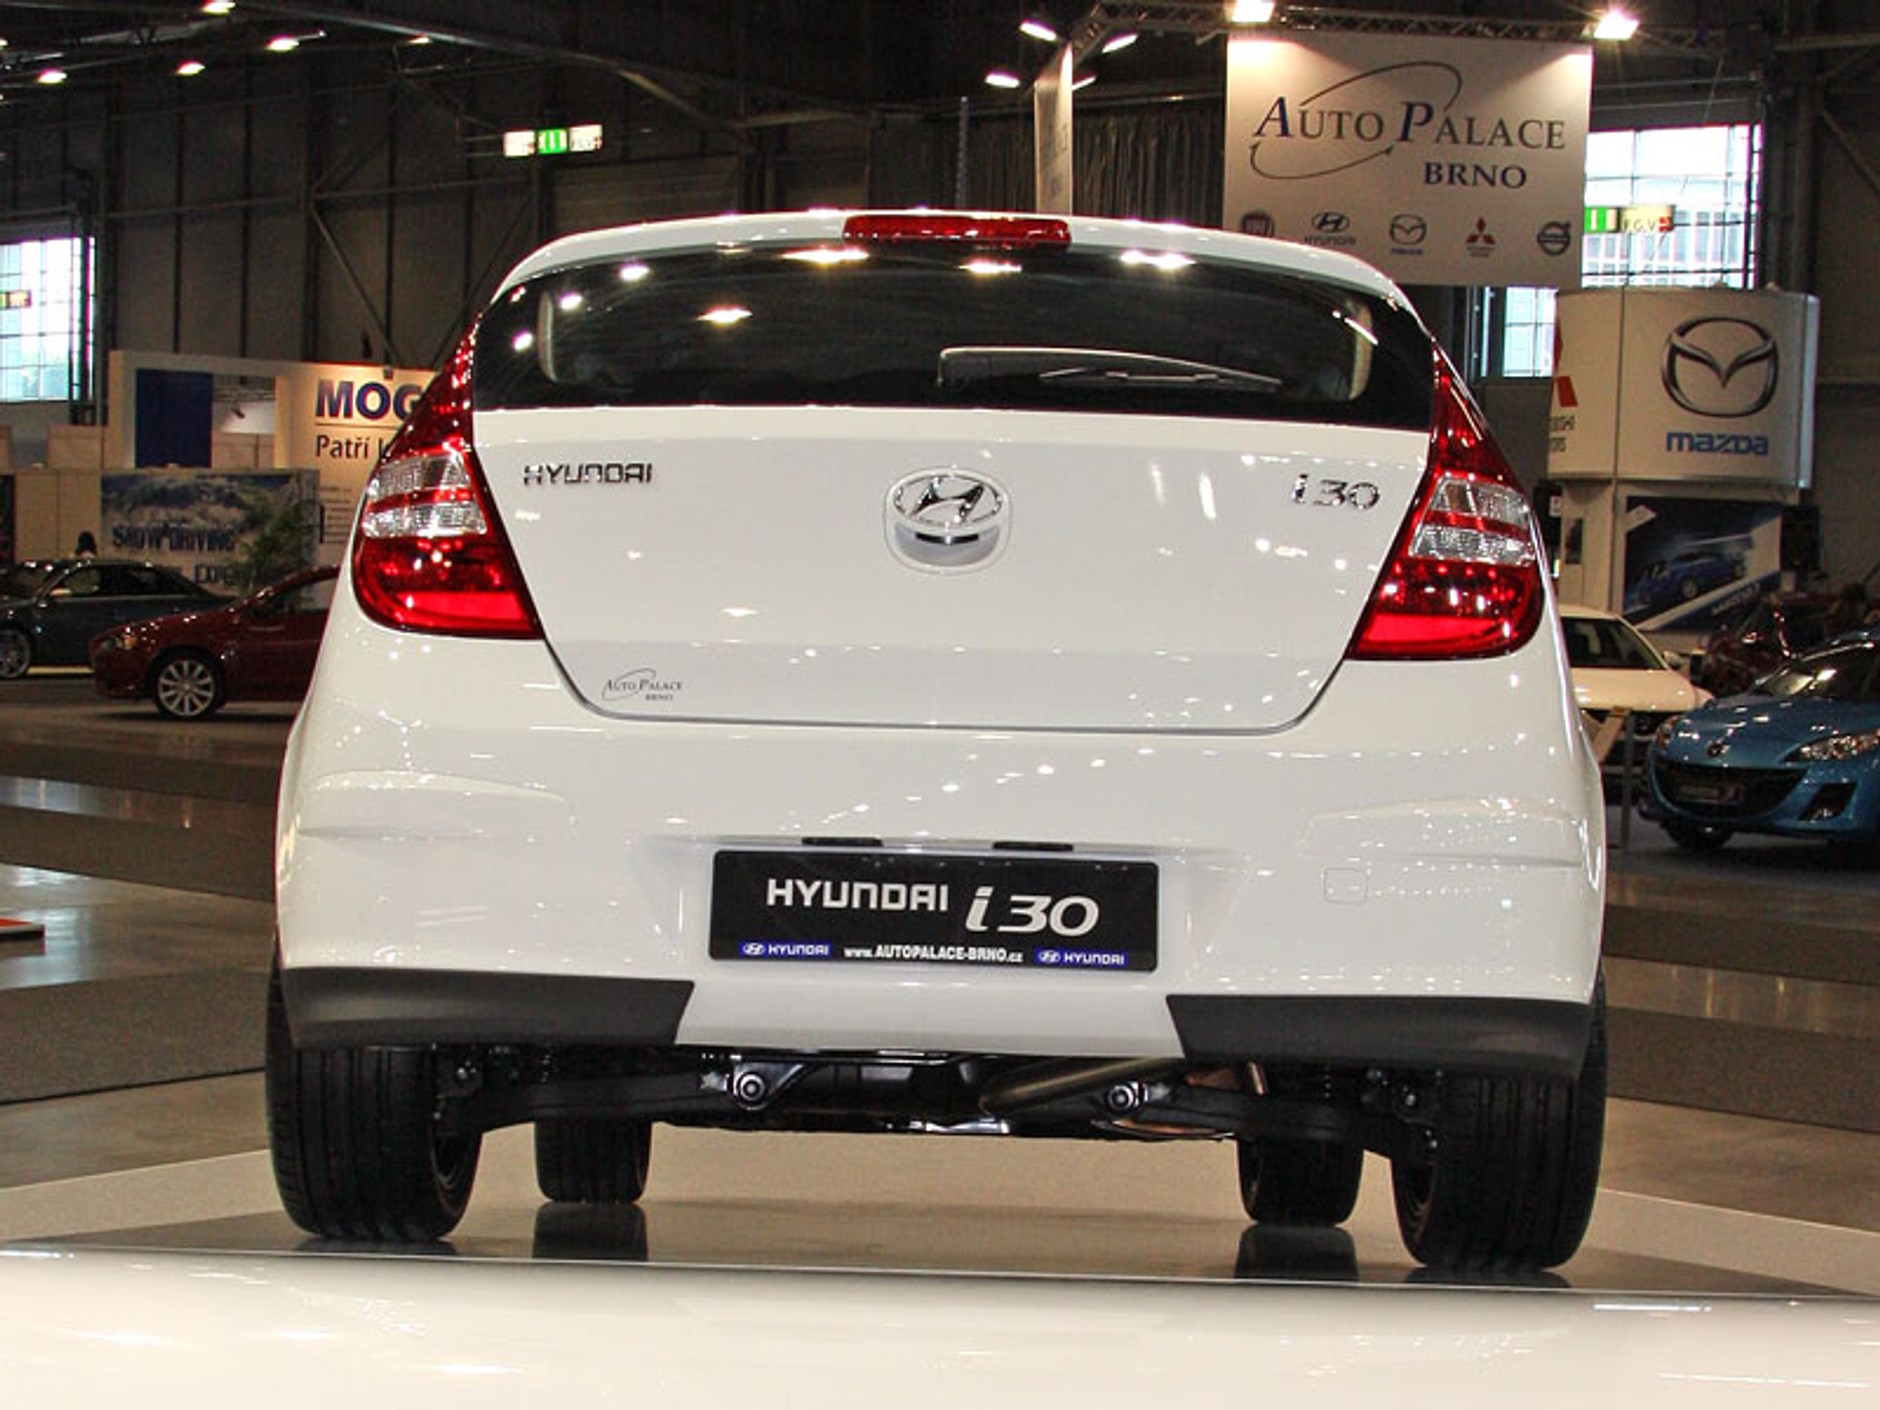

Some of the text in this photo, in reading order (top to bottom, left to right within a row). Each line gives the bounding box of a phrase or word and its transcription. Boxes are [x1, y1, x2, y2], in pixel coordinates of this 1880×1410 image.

[1253, 97, 1565, 149] AUTO PALACE
[1423, 161, 1527, 189] BRNO
[316, 435, 370, 459] Patří
[523, 463, 653, 485] HYUNDAI
[766, 879, 949, 912] HYUNDAI
[768, 944, 830, 956] HYUNDAI
[1064, 954, 1126, 966] HYUNDAI
